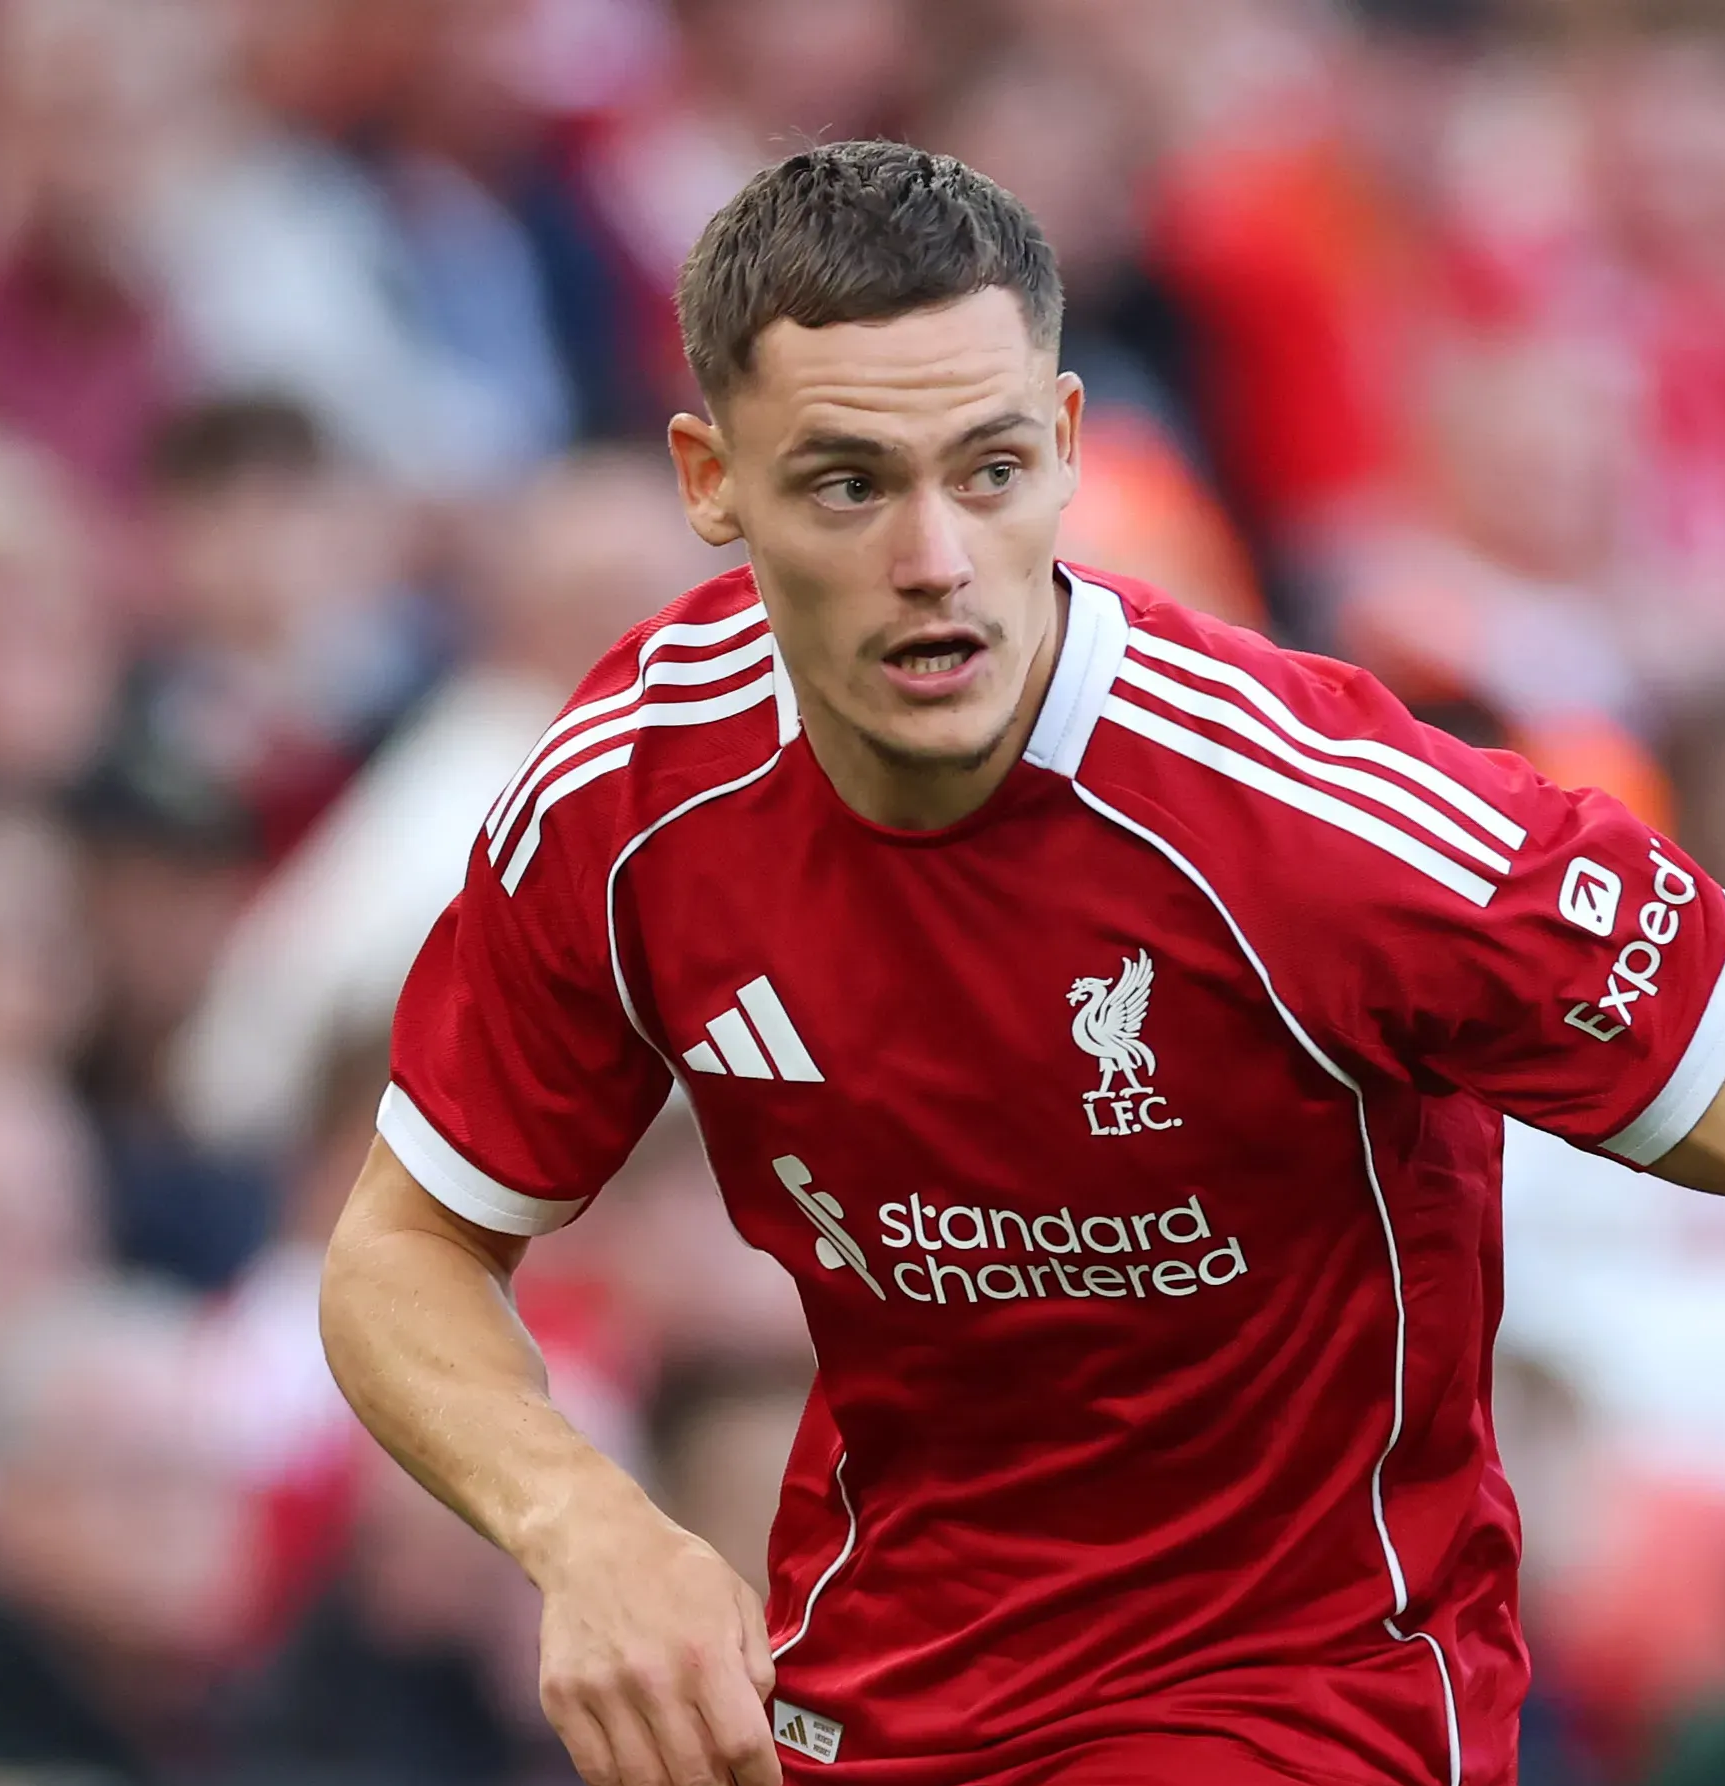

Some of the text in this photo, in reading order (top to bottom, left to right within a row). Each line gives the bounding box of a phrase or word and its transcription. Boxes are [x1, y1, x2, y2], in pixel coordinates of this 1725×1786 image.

[1083, 1096, 1183, 1136] L.F.C.
[878, 1192, 1212, 1253] standard
[893, 1236, 1249, 1305] chartered
